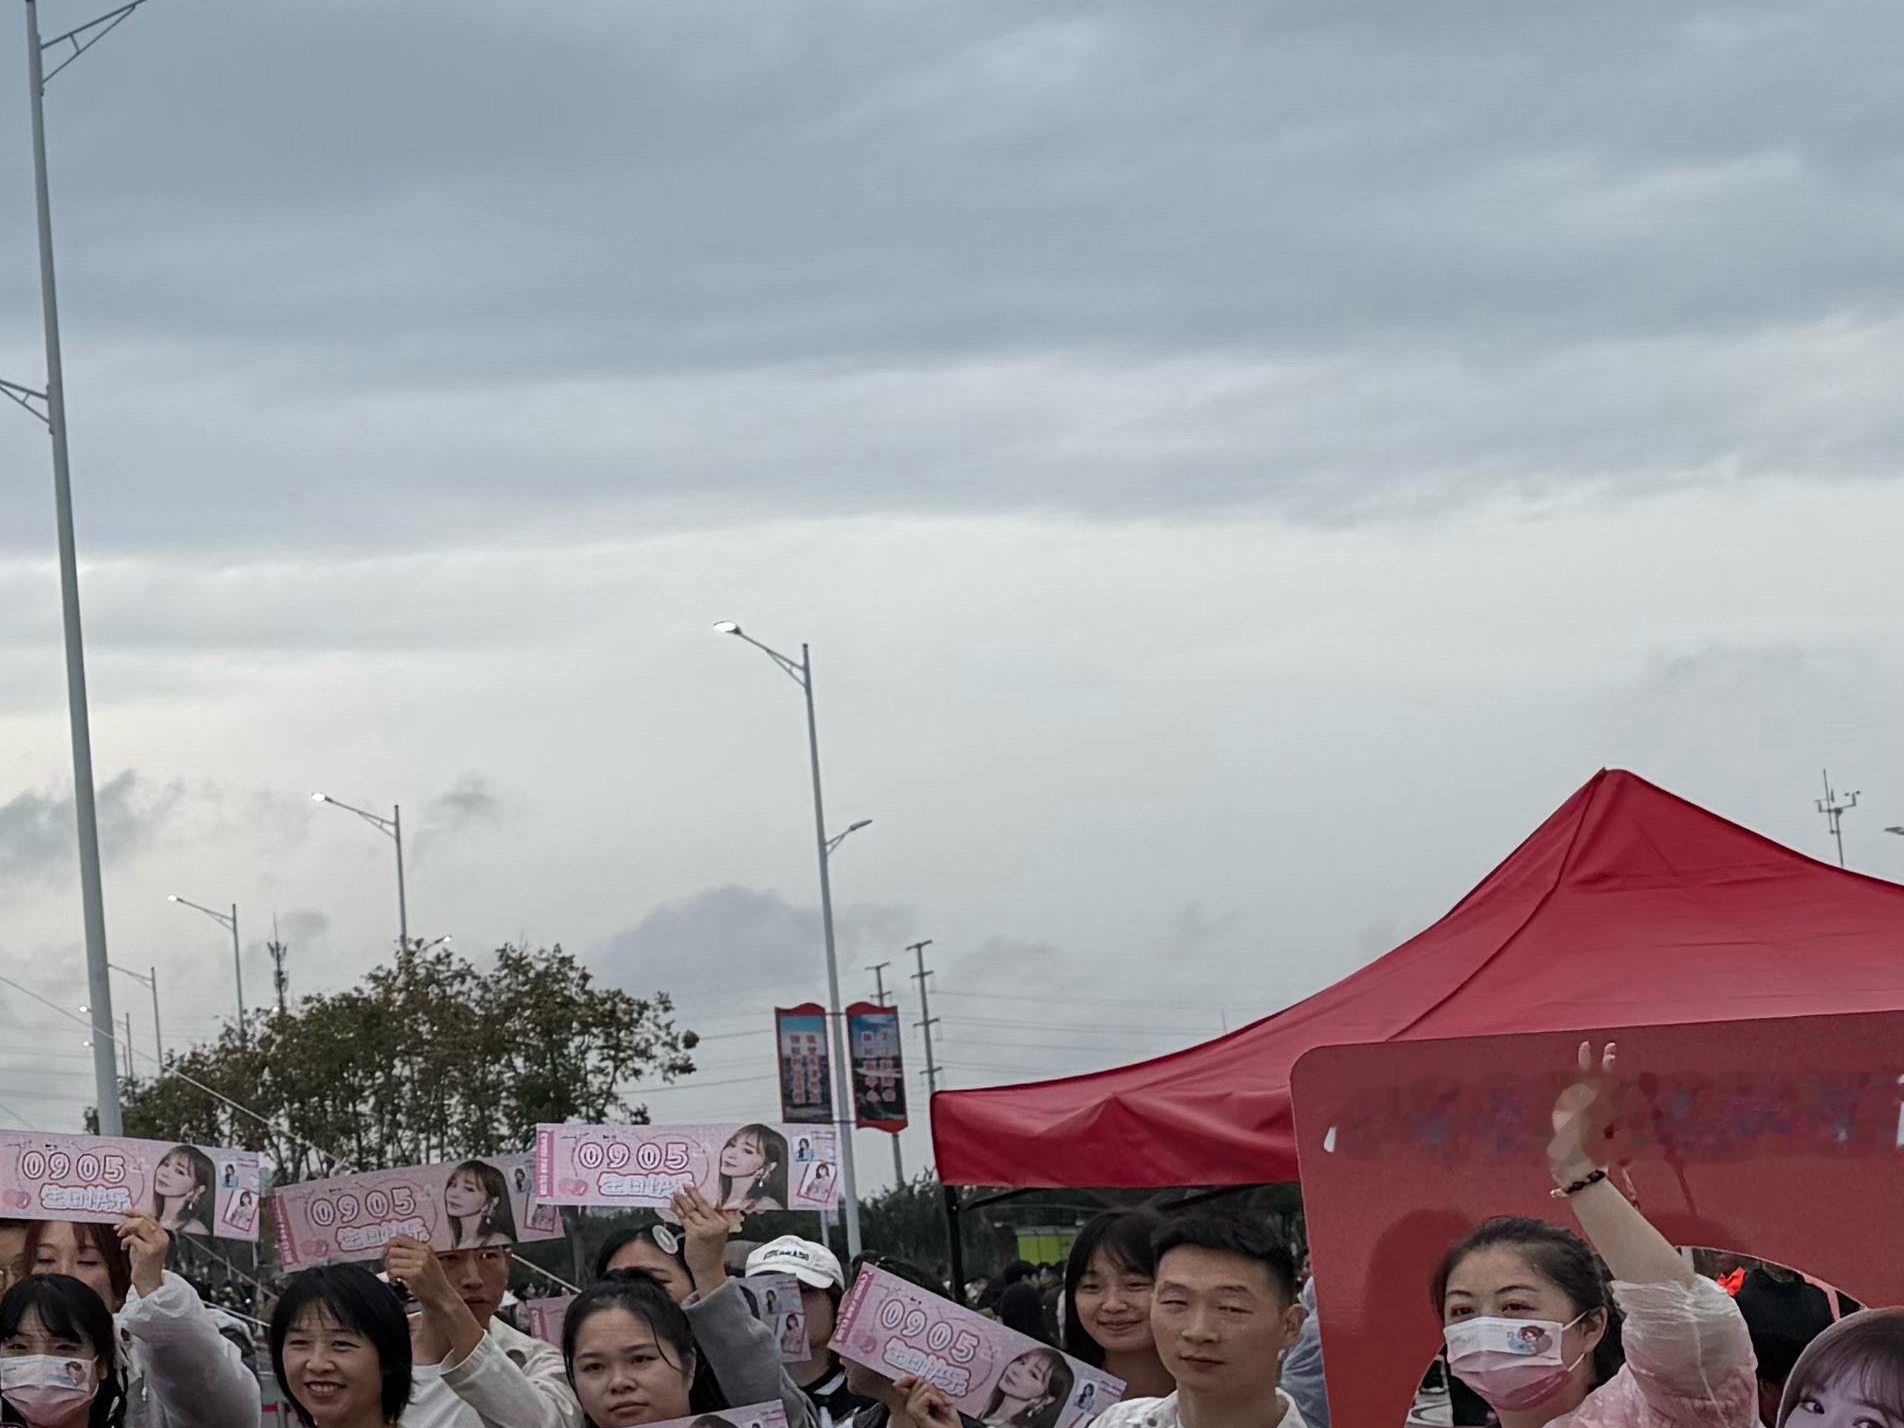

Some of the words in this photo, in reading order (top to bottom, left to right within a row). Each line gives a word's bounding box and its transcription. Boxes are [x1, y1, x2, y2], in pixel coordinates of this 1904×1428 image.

[21, 1150, 126, 1183] 0905
[578, 1142, 690, 1170] 0905
[311, 1186, 417, 1227] 0905
[880, 1299, 980, 1363] 0905
